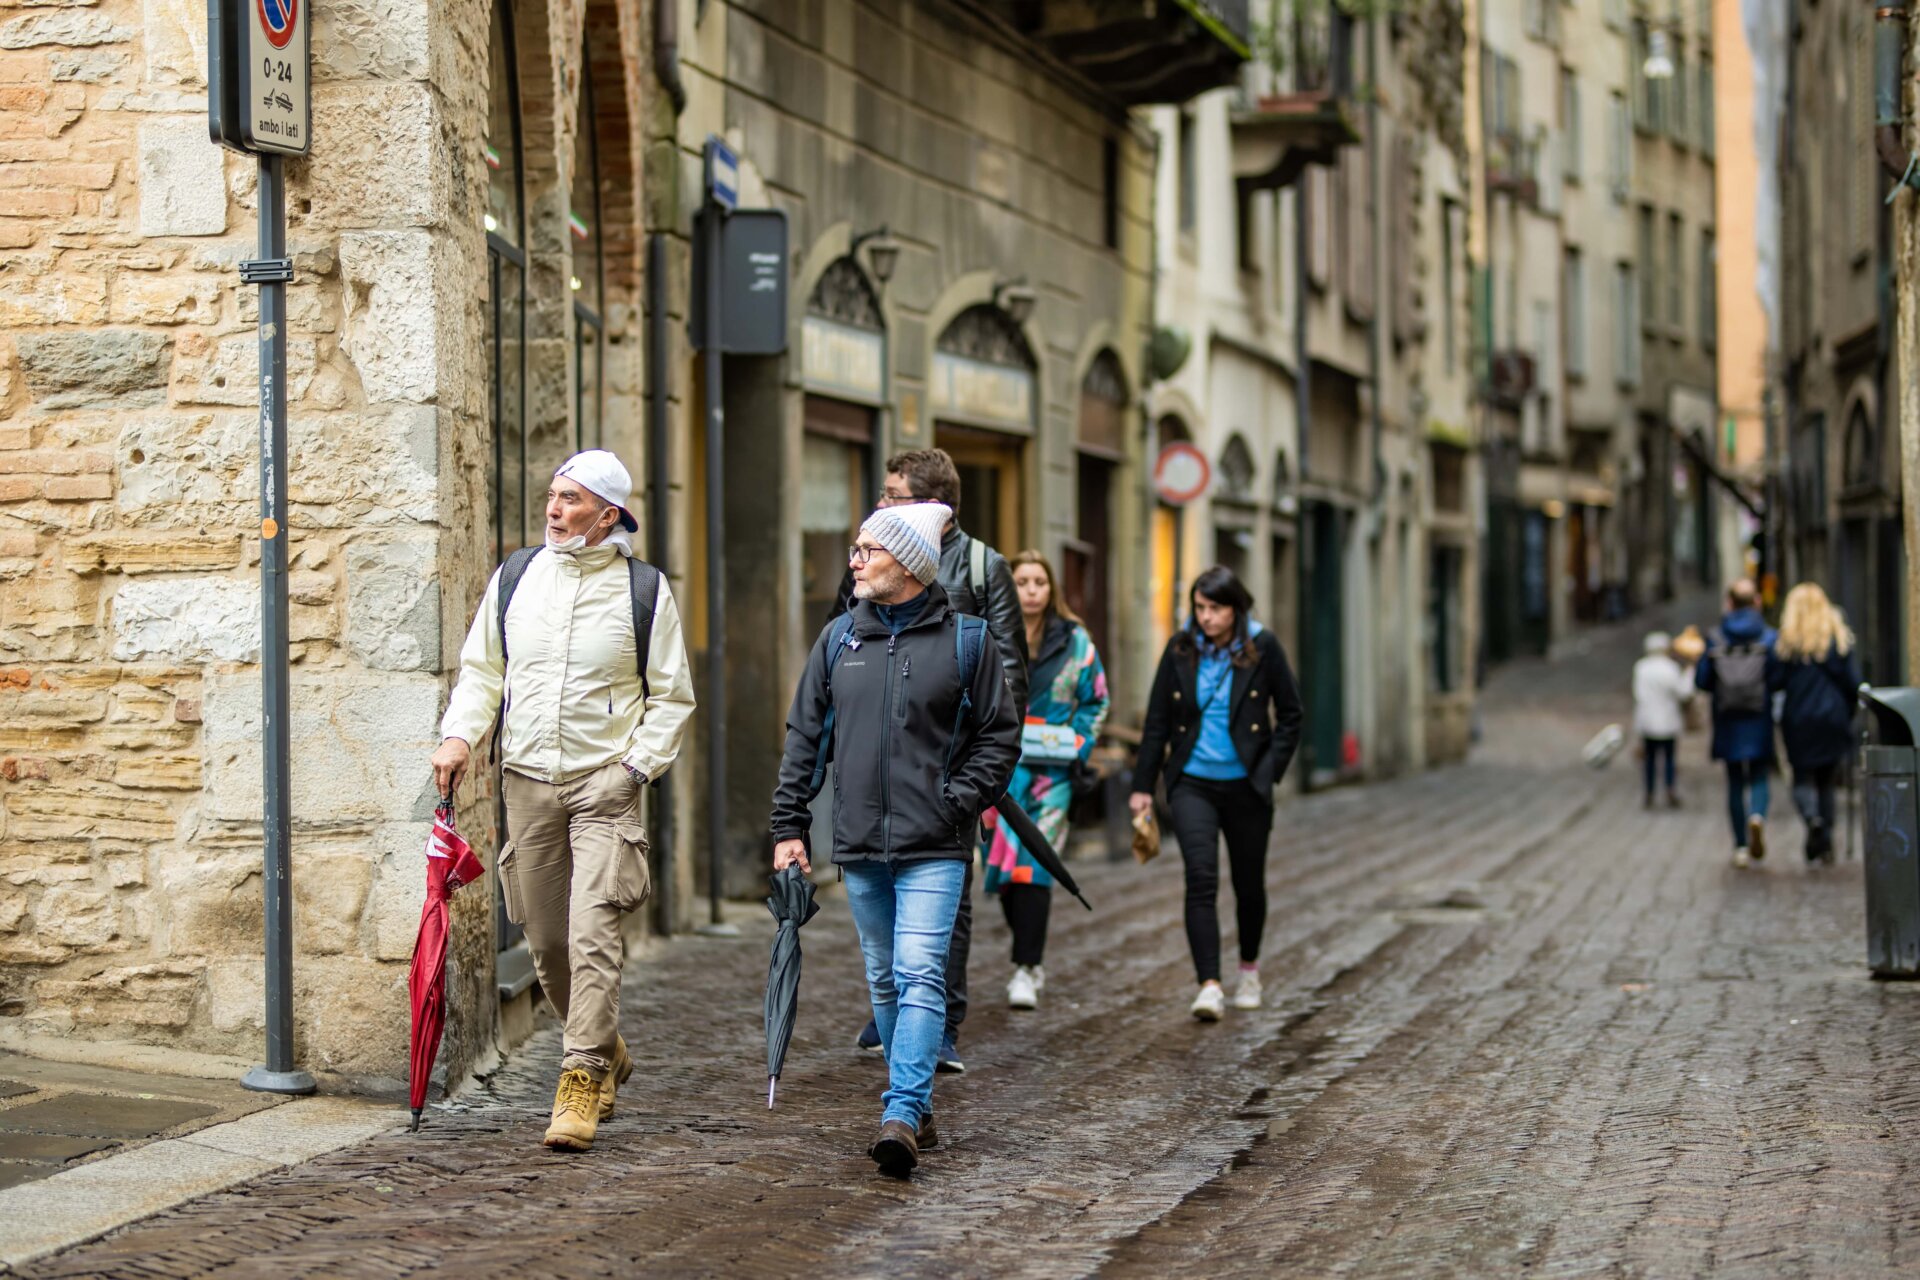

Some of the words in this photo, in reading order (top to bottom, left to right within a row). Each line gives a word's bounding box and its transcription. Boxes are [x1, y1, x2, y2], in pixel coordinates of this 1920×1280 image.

[259, 118, 279, 134] ambo
[281, 121, 284, 135] i
[286, 122, 298, 138] lati
